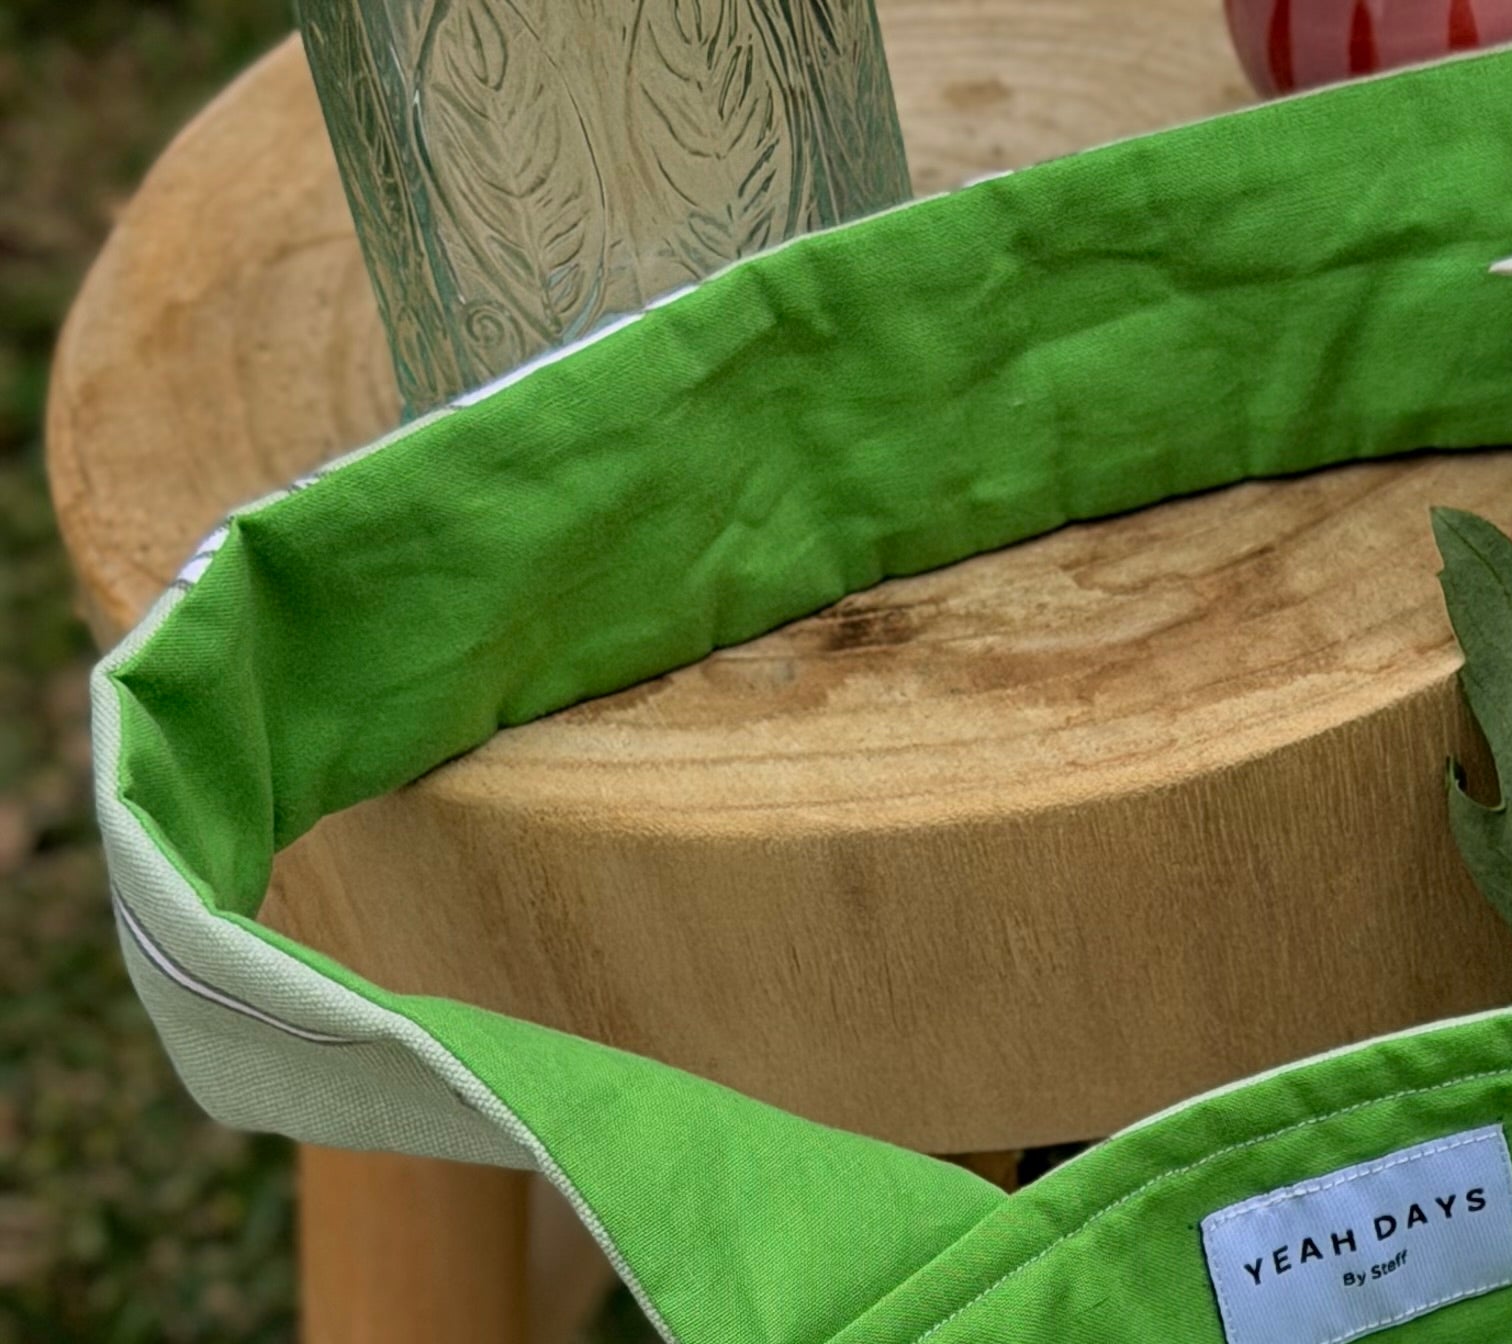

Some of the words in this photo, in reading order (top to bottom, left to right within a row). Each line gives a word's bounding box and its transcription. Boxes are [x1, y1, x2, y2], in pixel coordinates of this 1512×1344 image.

[1244, 1229, 1357, 1286] YEAH
[1373, 1187, 1487, 1241] DAYS
[1343, 1271, 1366, 1287] By
[1371, 1249, 1408, 1280] Steff
